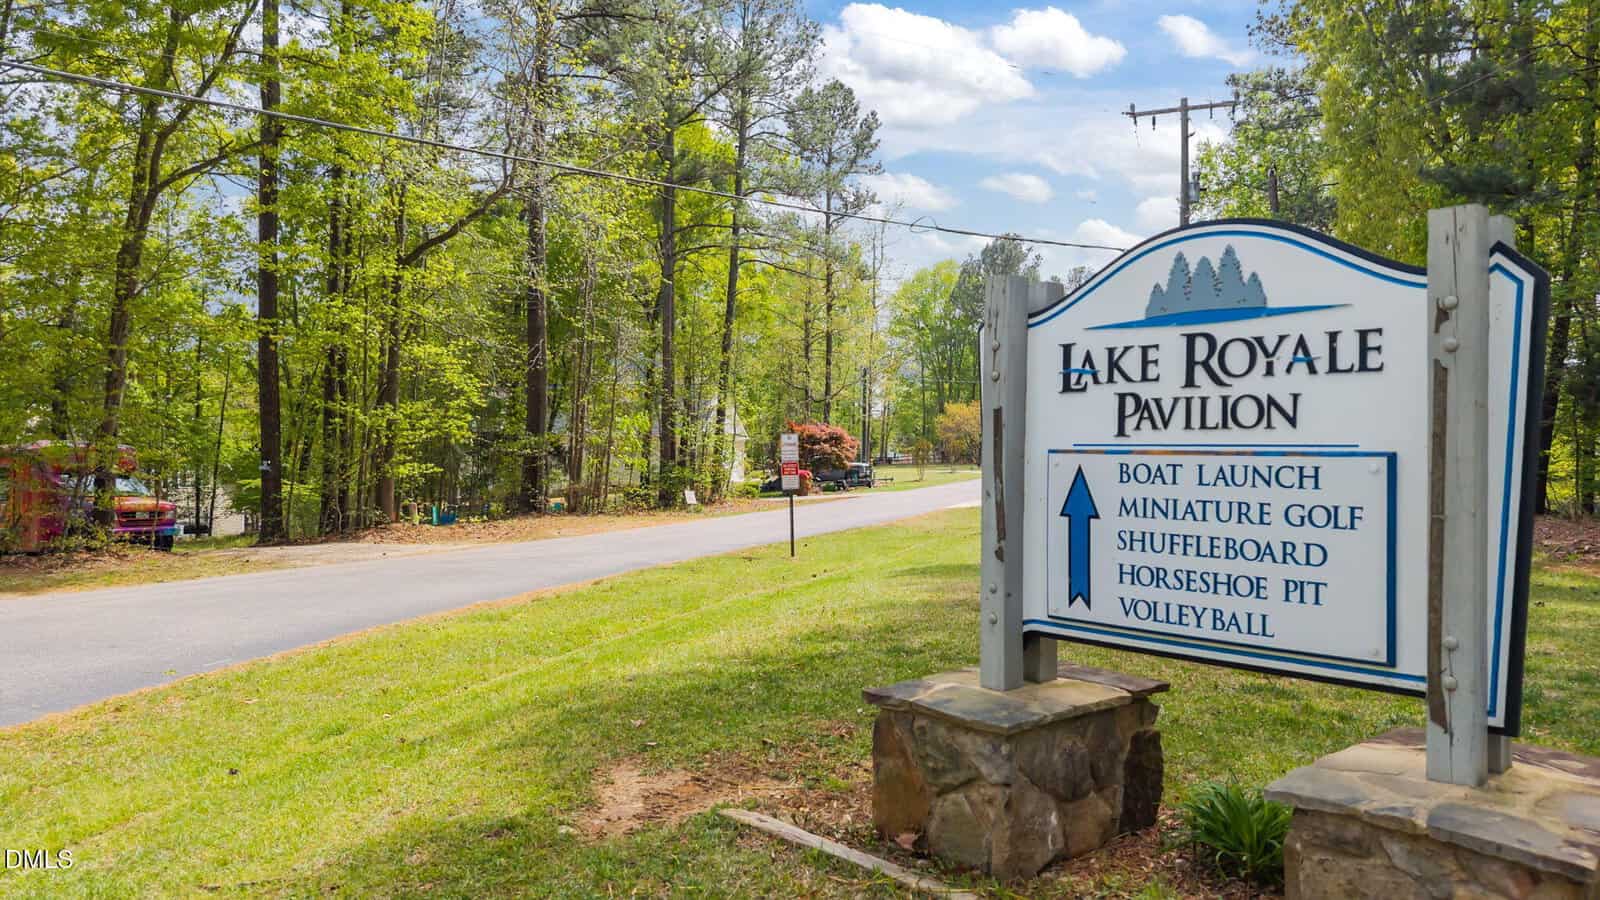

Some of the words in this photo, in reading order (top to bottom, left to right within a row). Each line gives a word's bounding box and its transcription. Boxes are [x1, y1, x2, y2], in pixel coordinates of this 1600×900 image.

[1059, 343, 1160, 394] LAKE
[1180, 327, 1385, 389] ROYALE
[1113, 392, 1302, 437] PAVILION
[1118, 463, 1183, 485] BOAT
[1197, 465, 1321, 490] LAUNCH
[1118, 497, 1272, 526] MINIATURE
[1284, 504, 1364, 531] GOLF
[1117, 530, 1328, 567] SHUFFLEBOARD
[1118, 564, 1268, 600] HORSESHOE
[1283, 579, 1328, 606] PIT
[1119, 597, 1275, 638] VOLLEYBALL
